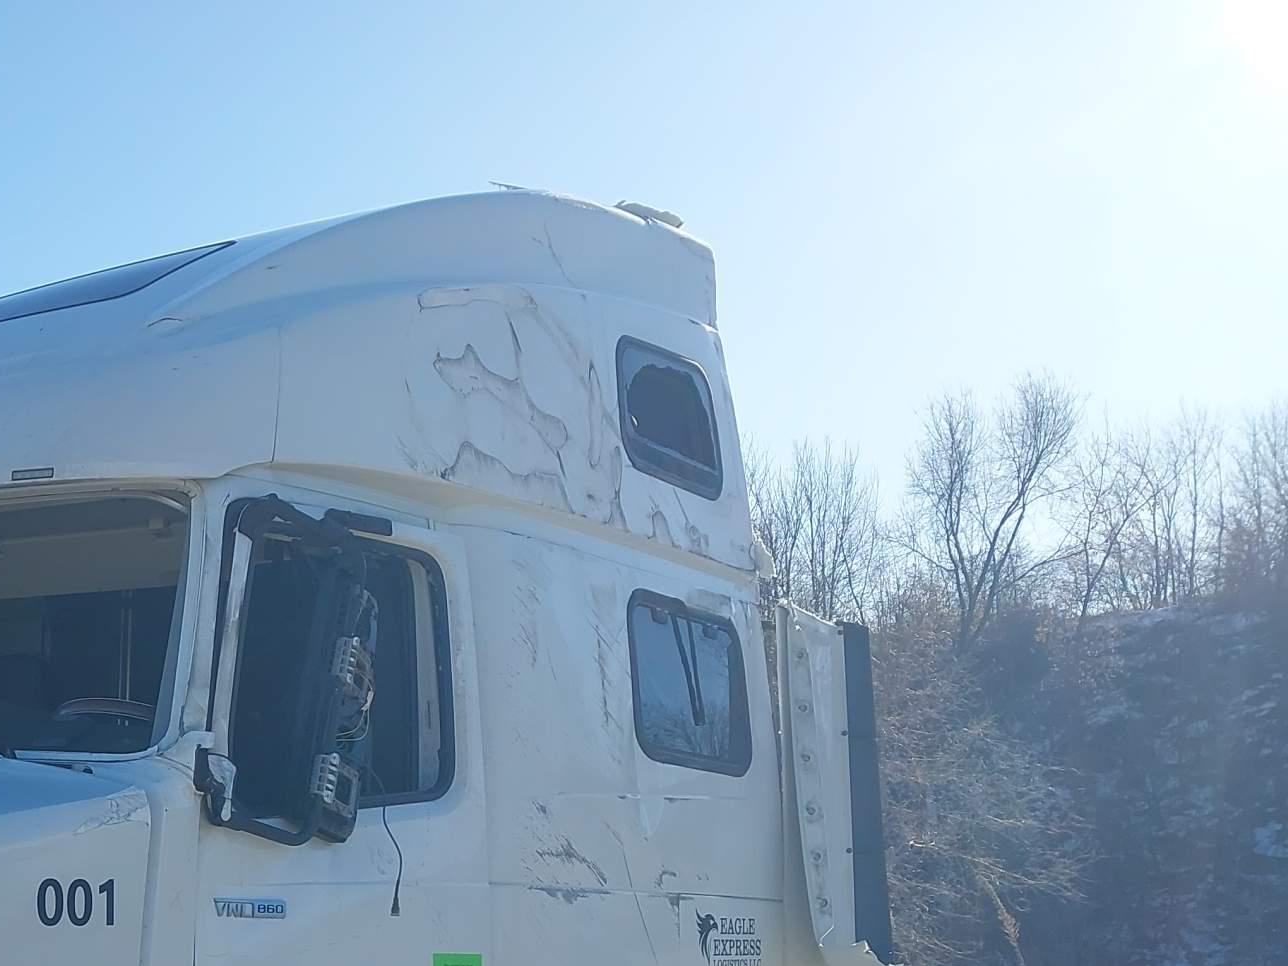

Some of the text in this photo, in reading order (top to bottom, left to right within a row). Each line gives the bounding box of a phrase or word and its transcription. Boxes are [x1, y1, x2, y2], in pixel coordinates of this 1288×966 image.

[37, 878, 115, 926] 001
[213, 897, 284, 918] VNL 860
[720, 917, 756, 935] EAGLE
[713, 939, 761, 956] EXPRESS
